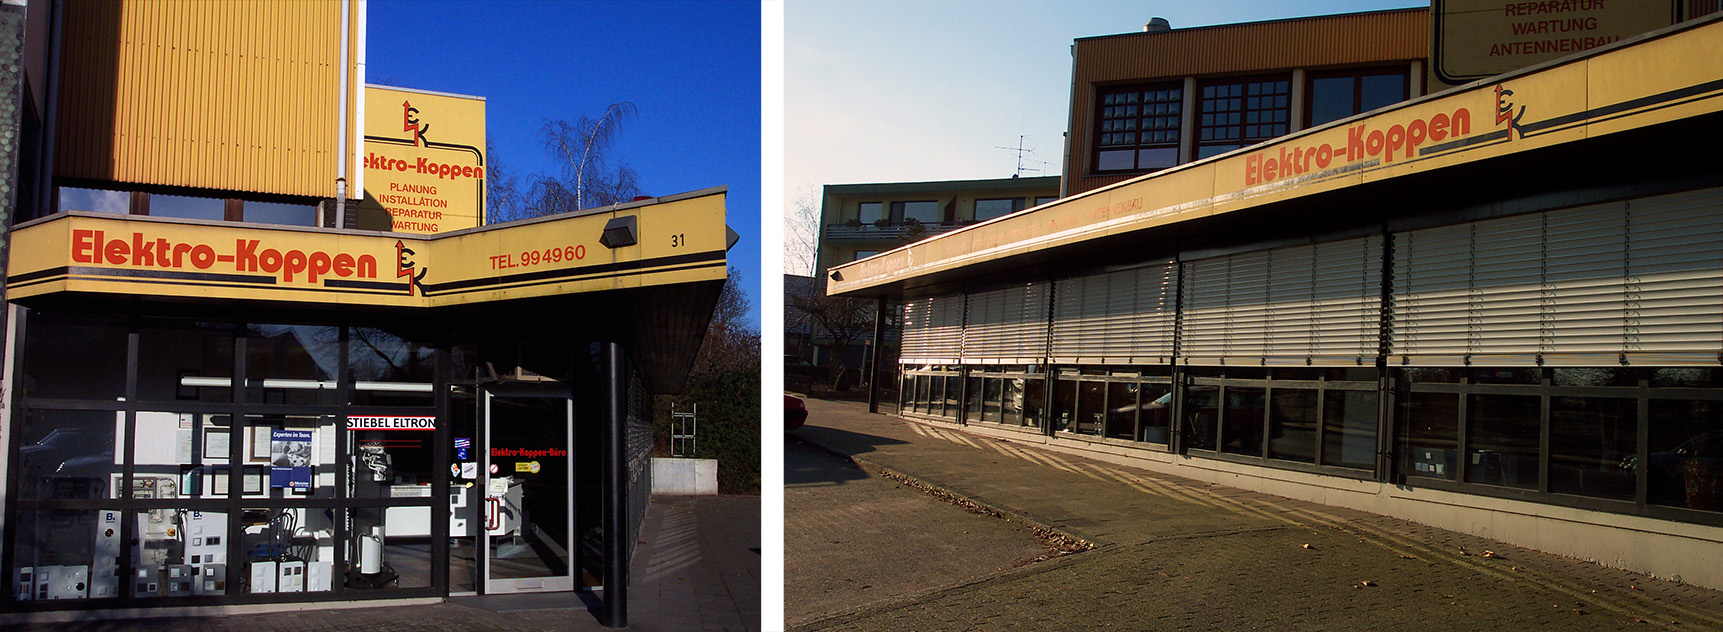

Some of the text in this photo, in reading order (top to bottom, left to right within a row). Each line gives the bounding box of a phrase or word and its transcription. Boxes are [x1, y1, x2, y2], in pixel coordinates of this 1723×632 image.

[1505, 0, 1604, 17] REPARATUR
[1512, 17, 1598, 36] WARTUNG
[1245, 107, 1471, 186] Elektro-Koppen
[390, 182, 437, 195] PLANUNG
[379, 194, 448, 208] INSTALLATION
[385, 207, 442, 220] REPARATUR
[389, 219, 439, 232] WARTUNG
[671, 233, 684, 248] 31
[72, 229, 377, 283] Elektro-Koppen
[346, 417, 436, 428] STIEBEL ELTRON
